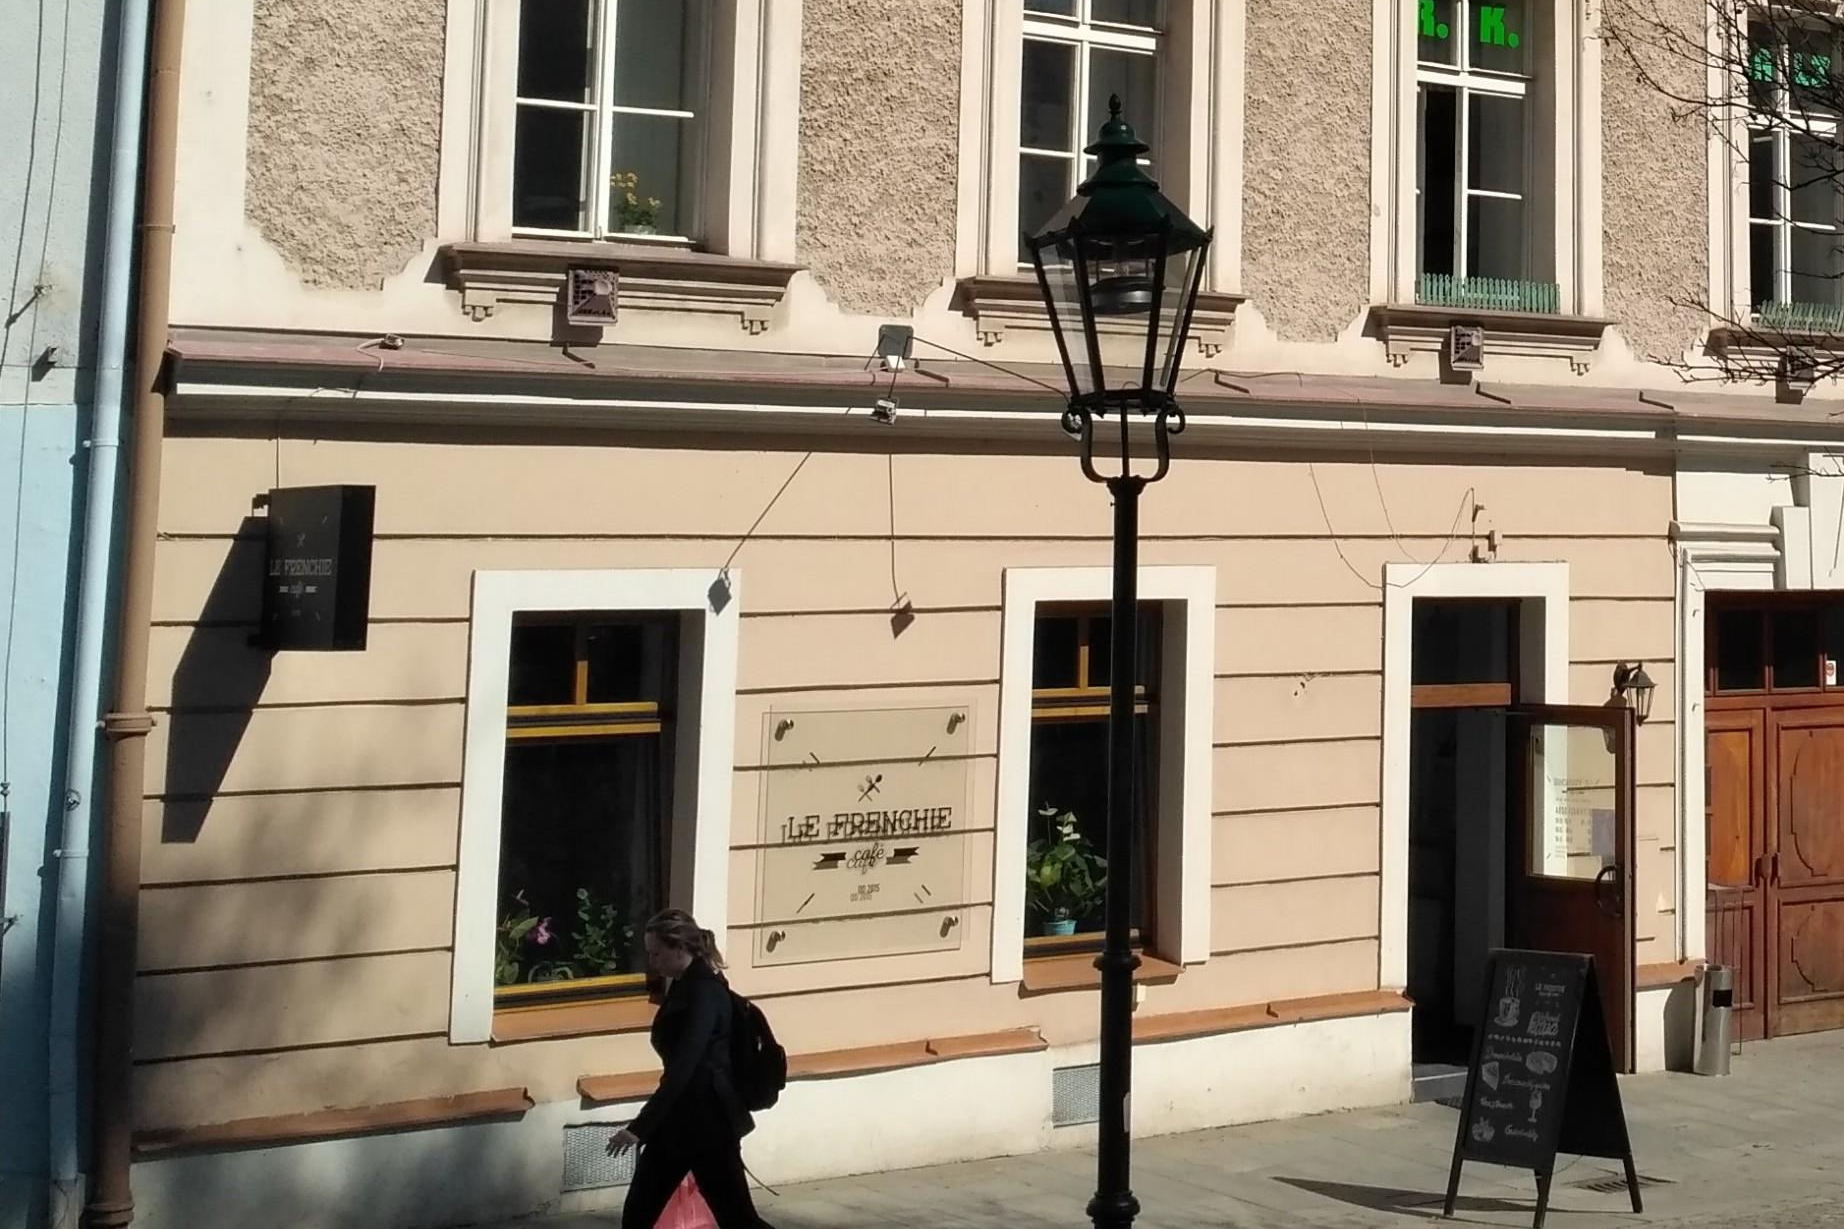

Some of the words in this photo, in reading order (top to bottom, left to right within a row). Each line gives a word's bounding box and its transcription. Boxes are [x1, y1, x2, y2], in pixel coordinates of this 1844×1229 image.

[1480, 5, 1520, 49] K.
[284, 558, 333, 576] FRENCHIE
[787, 815, 820, 839] LE
[832, 806, 952, 837] FRENCHIE
[853, 842, 885, 867] café
